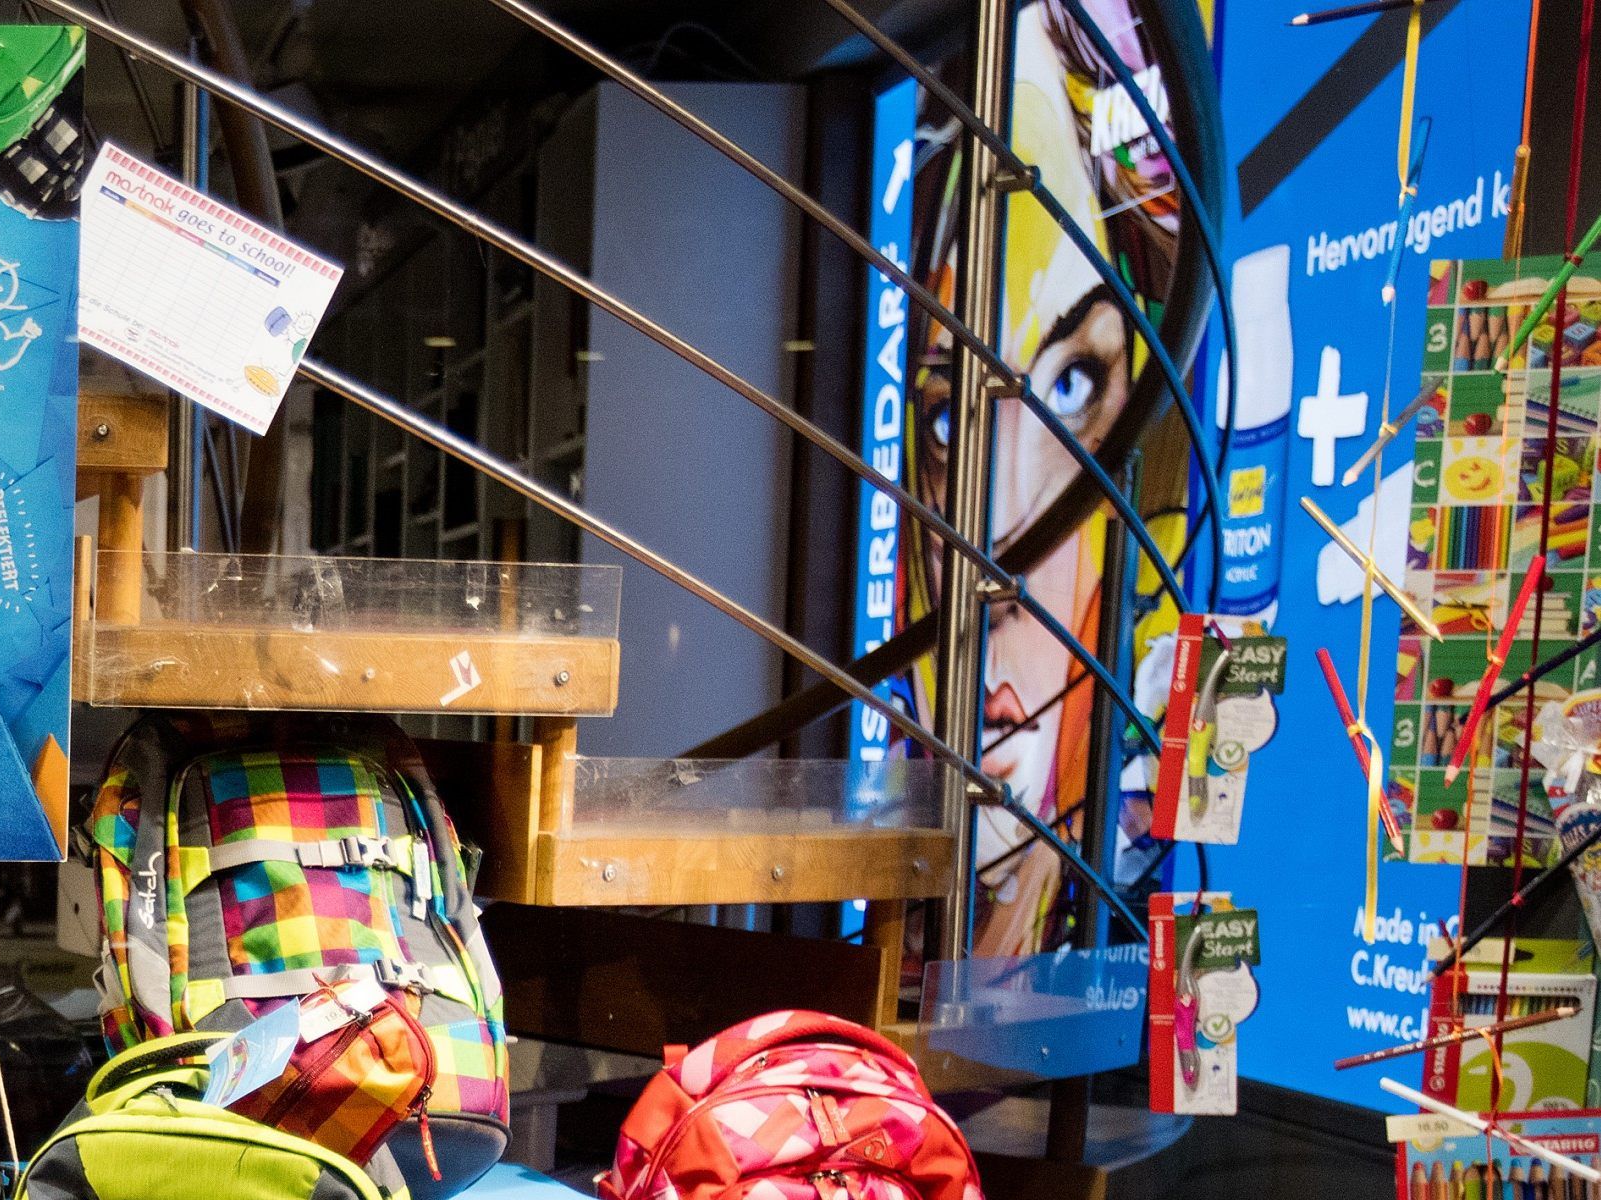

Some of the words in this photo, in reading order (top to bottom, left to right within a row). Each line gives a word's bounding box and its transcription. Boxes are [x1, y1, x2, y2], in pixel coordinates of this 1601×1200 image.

[106, 170, 177, 215] mastnak
[177, 208, 215, 235] goes
[218, 228, 236, 246] to
[239, 242, 297, 279] school!
[1414, 460, 1436, 488] C
[1232, 645, 1286, 665] EASY
[1226, 665, 1279, 684] Start
[137, 851, 163, 930] Satch
[1201, 919, 1257, 939] EASY
[1202, 940, 1254, 958] Start
